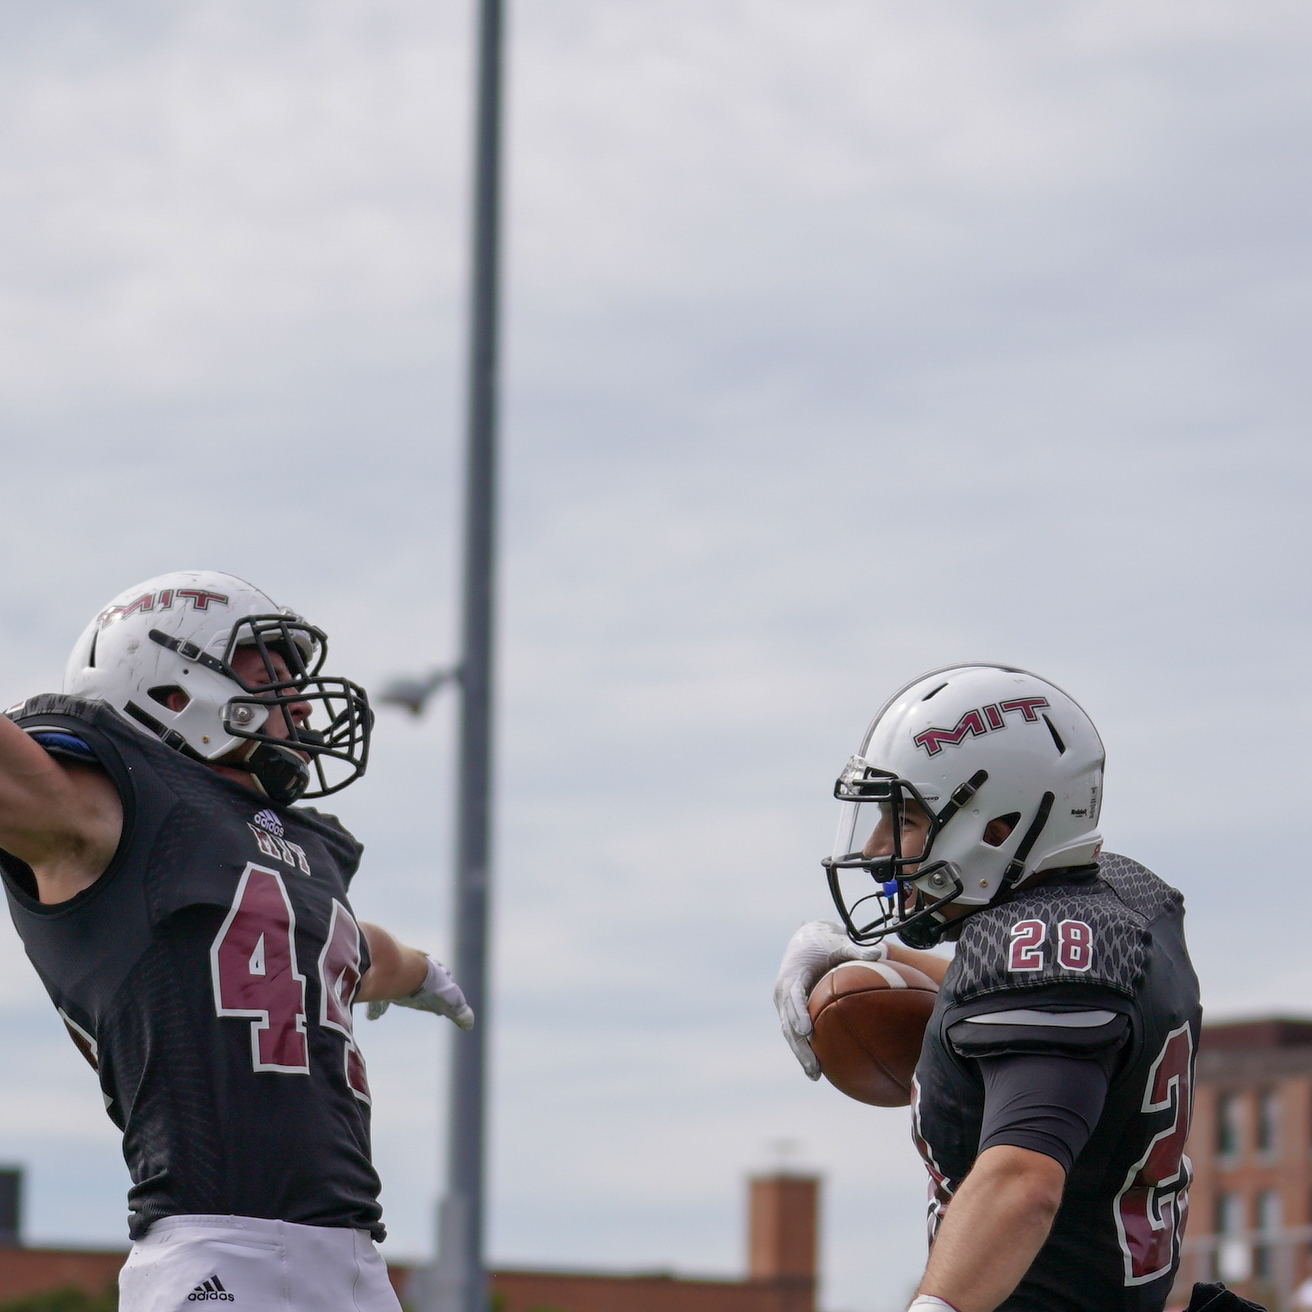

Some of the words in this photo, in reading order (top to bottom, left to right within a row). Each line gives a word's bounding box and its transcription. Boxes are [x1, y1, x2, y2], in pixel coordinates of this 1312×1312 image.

[96, 588, 230, 630] MIT
[912, 696, 1051, 758] MIT
[246, 821, 312, 877] MIT
[253, 812, 286, 839] adidas
[1007, 918, 1094, 973] 28
[1112, 1019, 1195, 1287] 2
[187, 1290, 235, 1302] adidas
